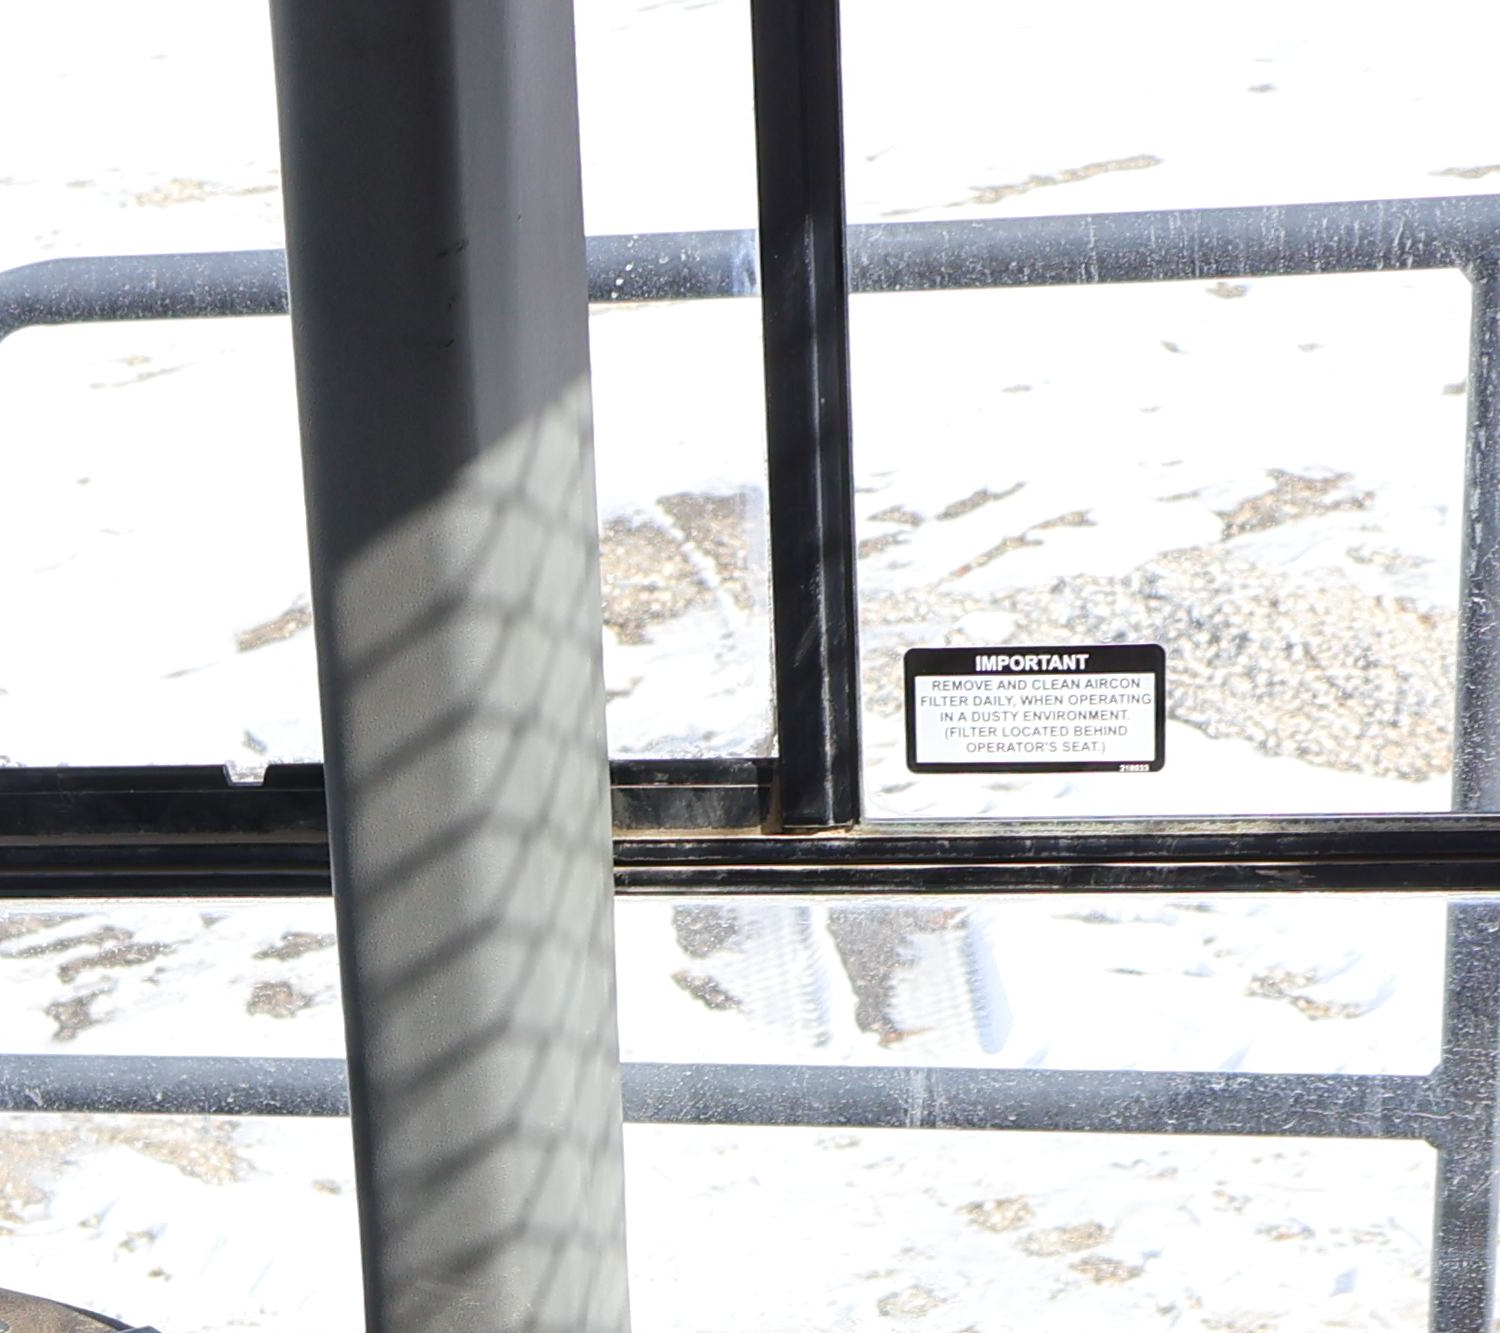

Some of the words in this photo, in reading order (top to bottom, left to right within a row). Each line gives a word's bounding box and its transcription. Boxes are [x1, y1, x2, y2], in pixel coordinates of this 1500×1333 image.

[975, 654, 1089, 672] IMPORTANT
[932, 680, 993, 691] REMOVE
[997, 679, 1027, 691] AND
[1032, 679, 1080, 690] CLEAN
[1084, 678, 1141, 690] AIRCON
[921, 695, 968, 707] FILTER
[973, 695, 1016, 708] DAILY,
[1021, 695, 1064, 706] WHEN
[1068, 693, 1152, 705] OPERATING
[940, 712, 953, 722] IN
[958, 712, 967, 722] A
[972, 711, 1019, 722] DUSTY
[1023, 709, 1130, 721] ENVIRONMENT.
[945, 726, 997, 740] (FILTER
[1002, 726, 1069, 737] LOCATED
[1073, 725, 1128, 736] BEHIND
[966, 741, 1057, 753] OPERATOR'S
[1062, 741, 1105, 754] SEAT.)
